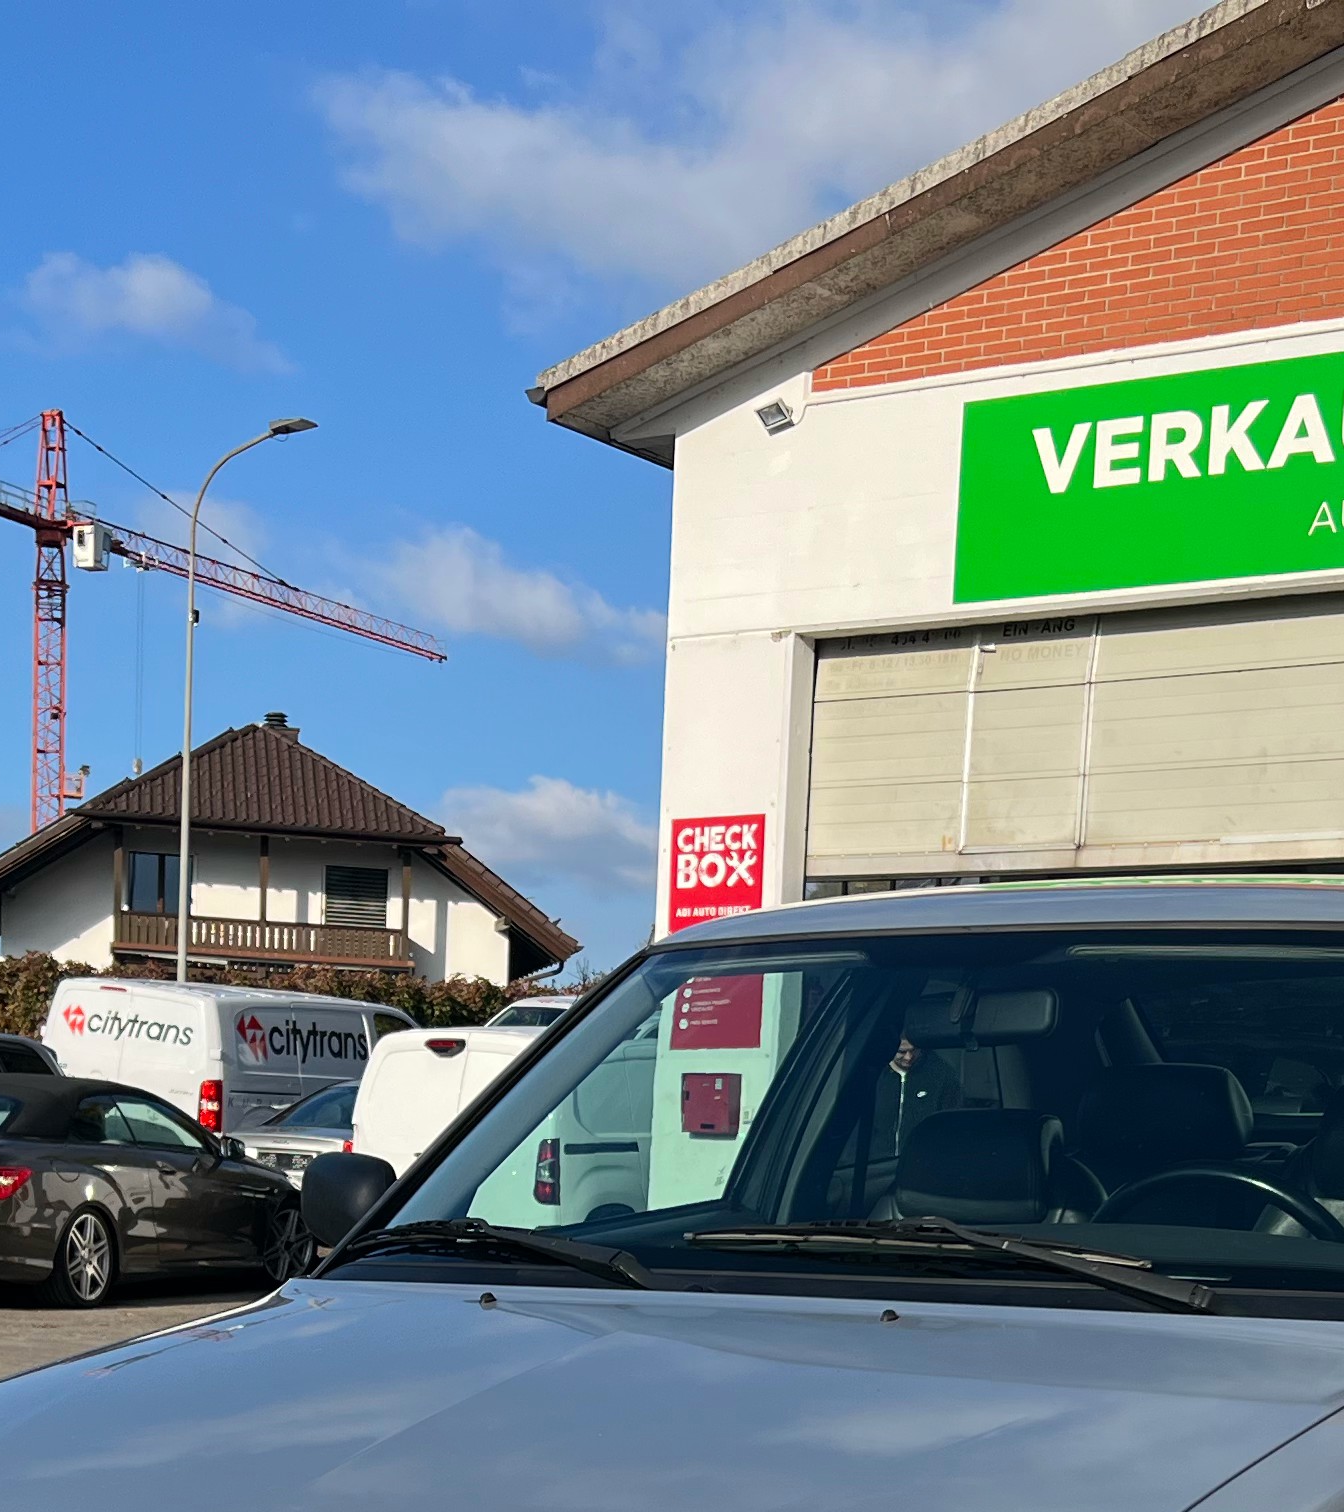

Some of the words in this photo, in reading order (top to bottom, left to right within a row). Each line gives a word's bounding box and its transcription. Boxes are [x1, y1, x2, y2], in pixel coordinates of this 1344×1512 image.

[677, 824, 758, 852] CHECK
[676, 851, 757, 889] BOX
[692, 906, 716, 917] AUTO
[87, 1011, 194, 1046] citytrans
[269, 1020, 369, 1062] citytrans
